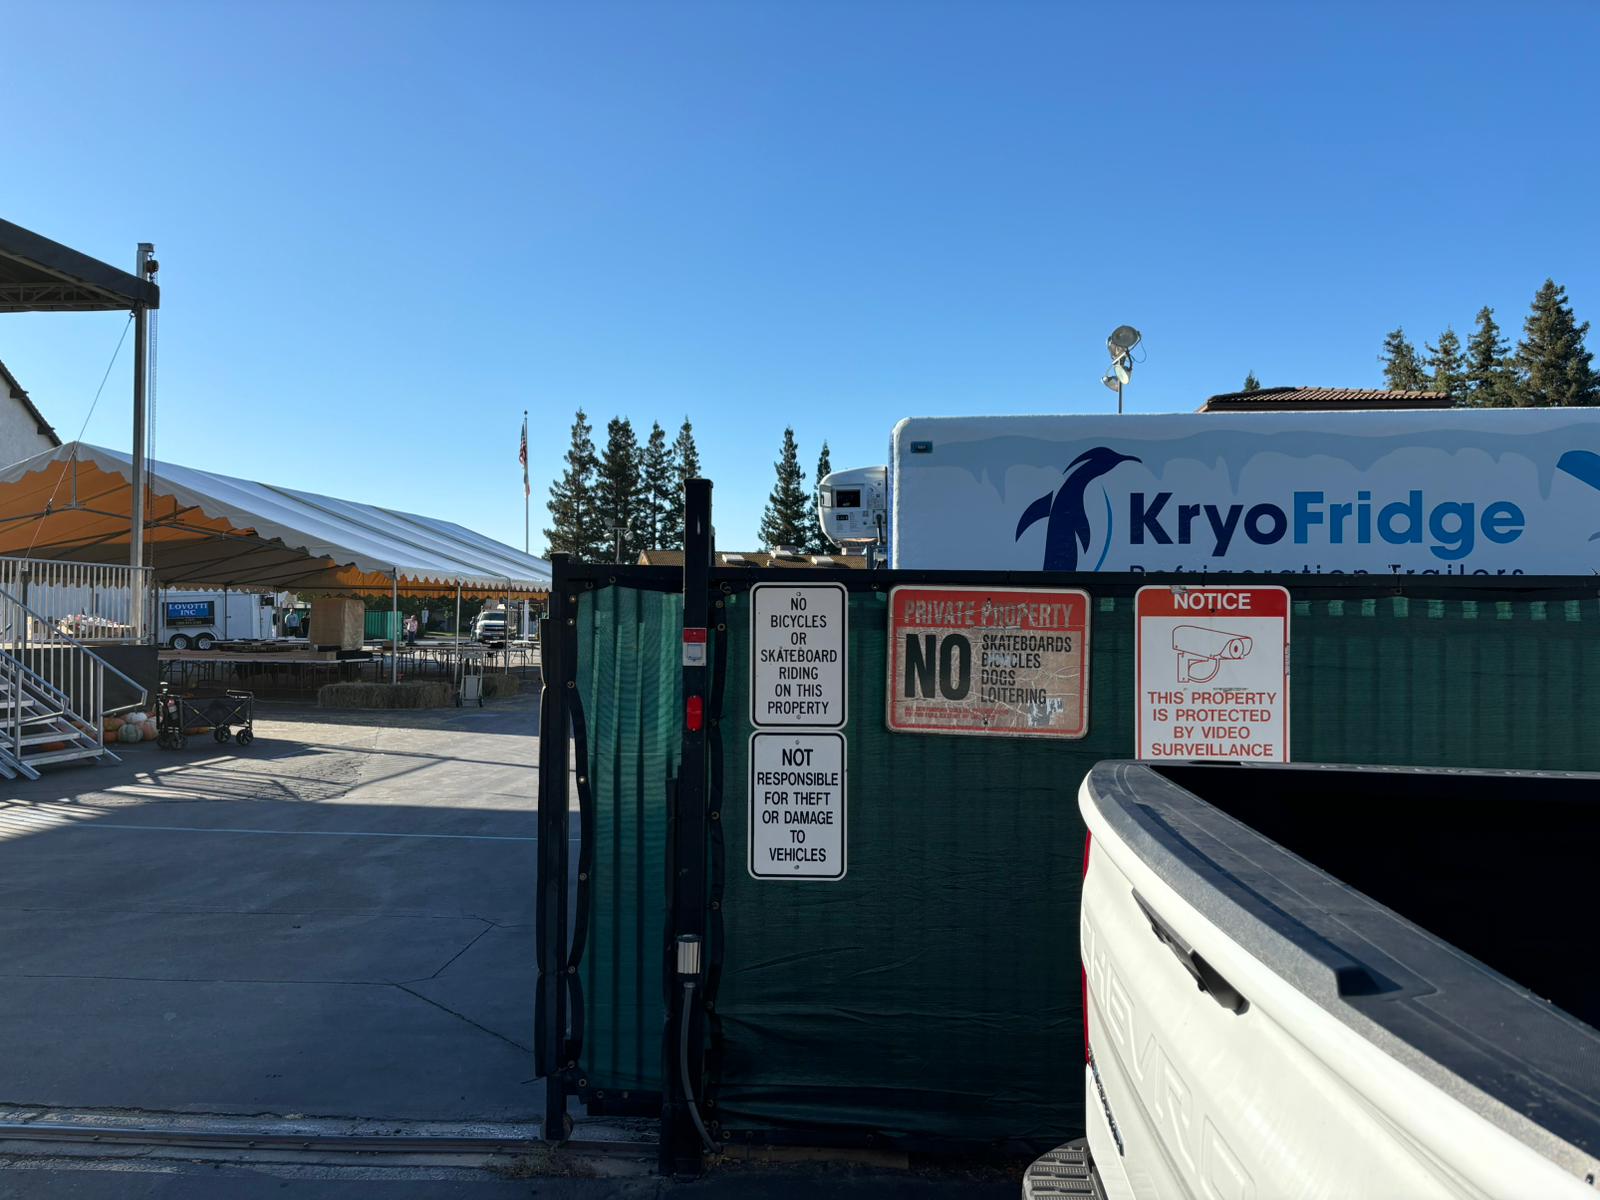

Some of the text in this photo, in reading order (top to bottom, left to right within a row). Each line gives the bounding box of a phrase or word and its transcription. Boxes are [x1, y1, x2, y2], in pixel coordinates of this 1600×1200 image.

[1129, 490, 1526, 561] KryoFridge
[790, 597, 807, 611] NO
[1173, 592, 1251, 610] NOTICE
[770, 614, 827, 628] BICYCLES
[904, 600, 1073, 628] PRIVATE PROPERTY
[790, 632, 807, 645] OR
[981, 634, 1072, 653] SKATEBOARDS
[760, 649, 837, 663] SKATEBOARD
[779, 666, 819, 680] RIDING
[904, 633, 972, 701] NO
[981, 669, 1016, 686] DOGS
[775, 684, 823, 697] ON THIS
[980, 687, 1047, 704] LOITERING
[1147, 691, 1277, 705] THIS PROPERTY
[767, 701, 829, 714] PROPERTY
[1153, 709, 1271, 722] IS PROTECTED
[1173, 726, 1250, 739] BY VIDEO
[782, 748, 814, 766] NOT
[1151, 743, 1273, 756] SURVEILLANCE
[757, 771, 839, 786] RESPONSIBLE
[764, 791, 831, 806] FOR THEFT
[762, 810, 833, 825] OR DAMAGE
[790, 829, 806, 844] TO
[769, 847, 827, 862] VEHICLES
